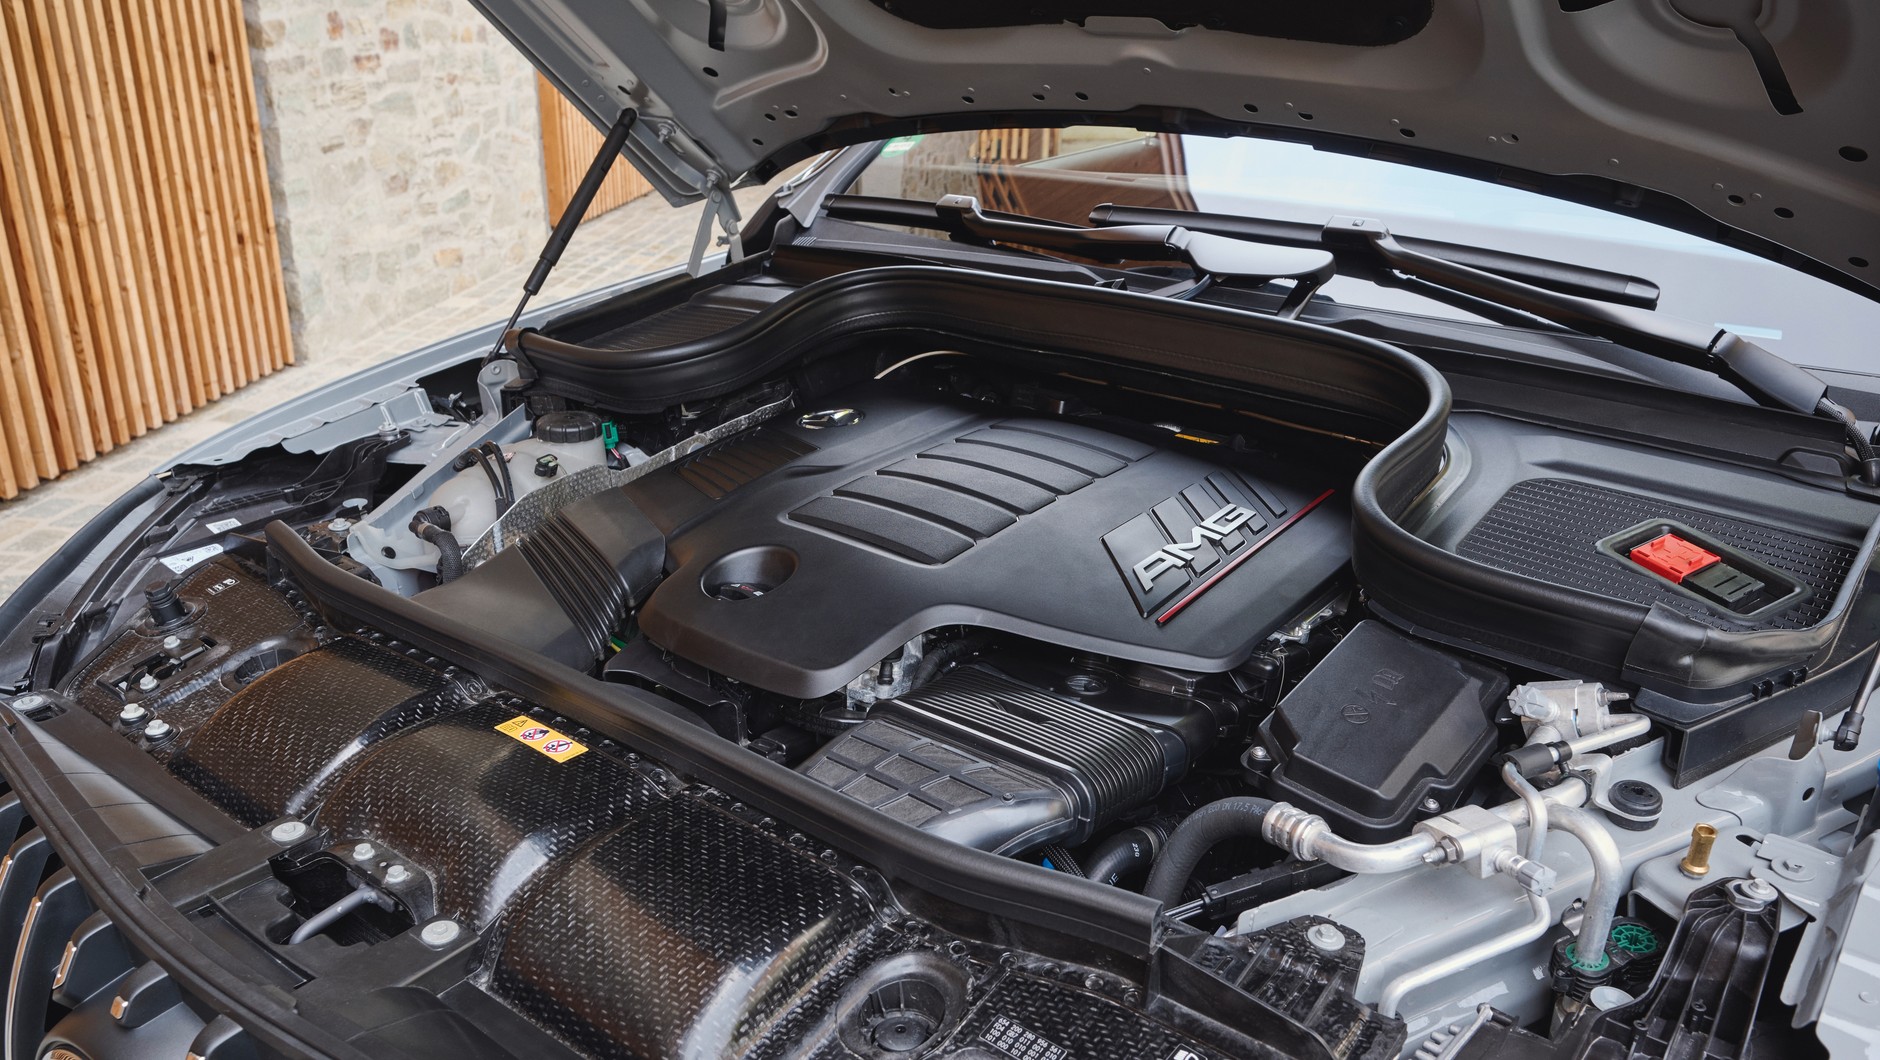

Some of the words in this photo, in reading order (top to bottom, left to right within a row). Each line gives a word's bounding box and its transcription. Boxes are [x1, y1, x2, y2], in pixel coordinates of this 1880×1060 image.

[1132, 503, 1257, 593] AMG
[985, 1033, 996, 1042] 101
[996, 1040, 1009, 1050] 000
[1010, 1047, 1022, 1057] 101
[989, 1028, 1001, 1037] 100
[1001, 1035, 1014, 1044] 010
[1014, 1042, 1027, 1052] 010
[1027, 1049, 1040, 1059] 001
[998, 1018, 1010, 1027] 654
[1010, 1024, 1023, 1034] 200
[1023, 1031, 1036, 1040] 280
[1036, 1038, 1049, 1047] 956
[1049, 1045, 1062, 1055] 561
[1019, 1036, 1031, 1046] 011
[1032, 1043, 1044, 1053] 001
[1044, 1051, 1057, 1060] 010
